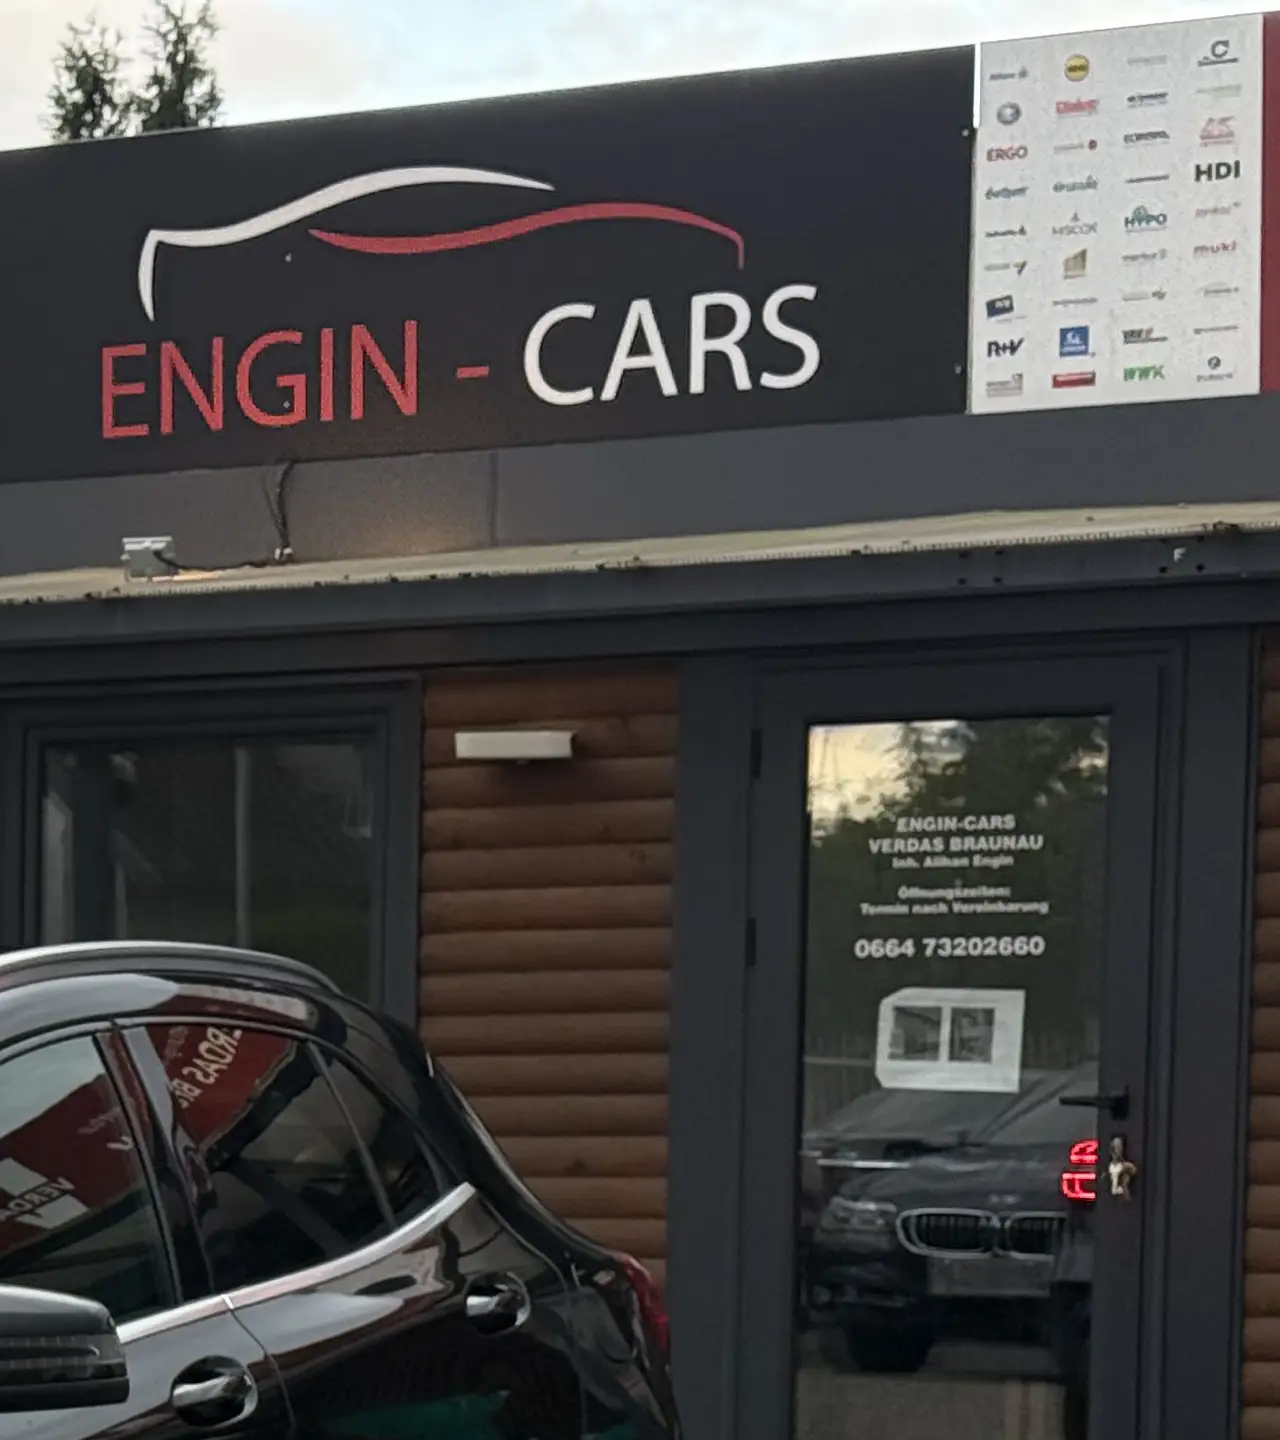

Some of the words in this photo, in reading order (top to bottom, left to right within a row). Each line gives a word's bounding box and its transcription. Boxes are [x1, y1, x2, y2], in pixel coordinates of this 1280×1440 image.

[986, 144, 1028, 162] ERGO
[1194, 160, 1241, 183] HDI
[101, 319, 419, 440] ENGIN
[523, 283, 822, 406] CARS
[896, 814, 1016, 833] ENGIN-CARS
[868, 837, 944, 854] VERDAS
[949, 835, 1045, 852] BRAUNAU
[853, 938, 916, 959] 0664
[922, 935, 1046, 958] 73202660
